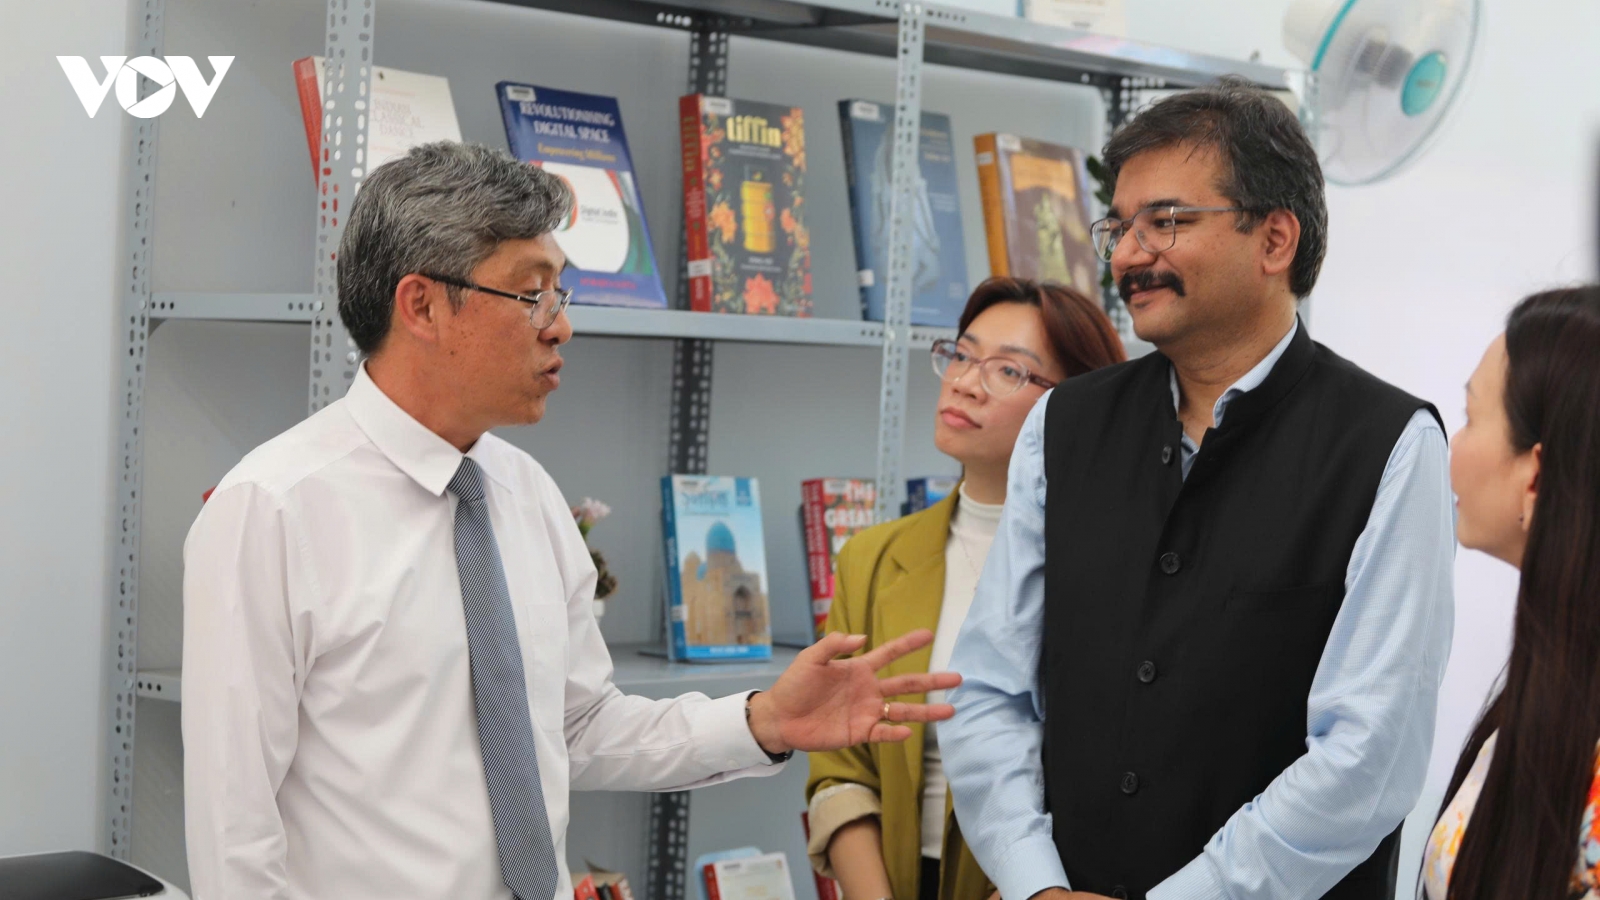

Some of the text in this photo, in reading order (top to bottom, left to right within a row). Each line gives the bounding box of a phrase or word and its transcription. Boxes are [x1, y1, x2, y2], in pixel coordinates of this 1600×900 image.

[519, 102, 616, 126] REVOLUTIONISING
[533, 120, 611, 144] DIGITAL SPACE
